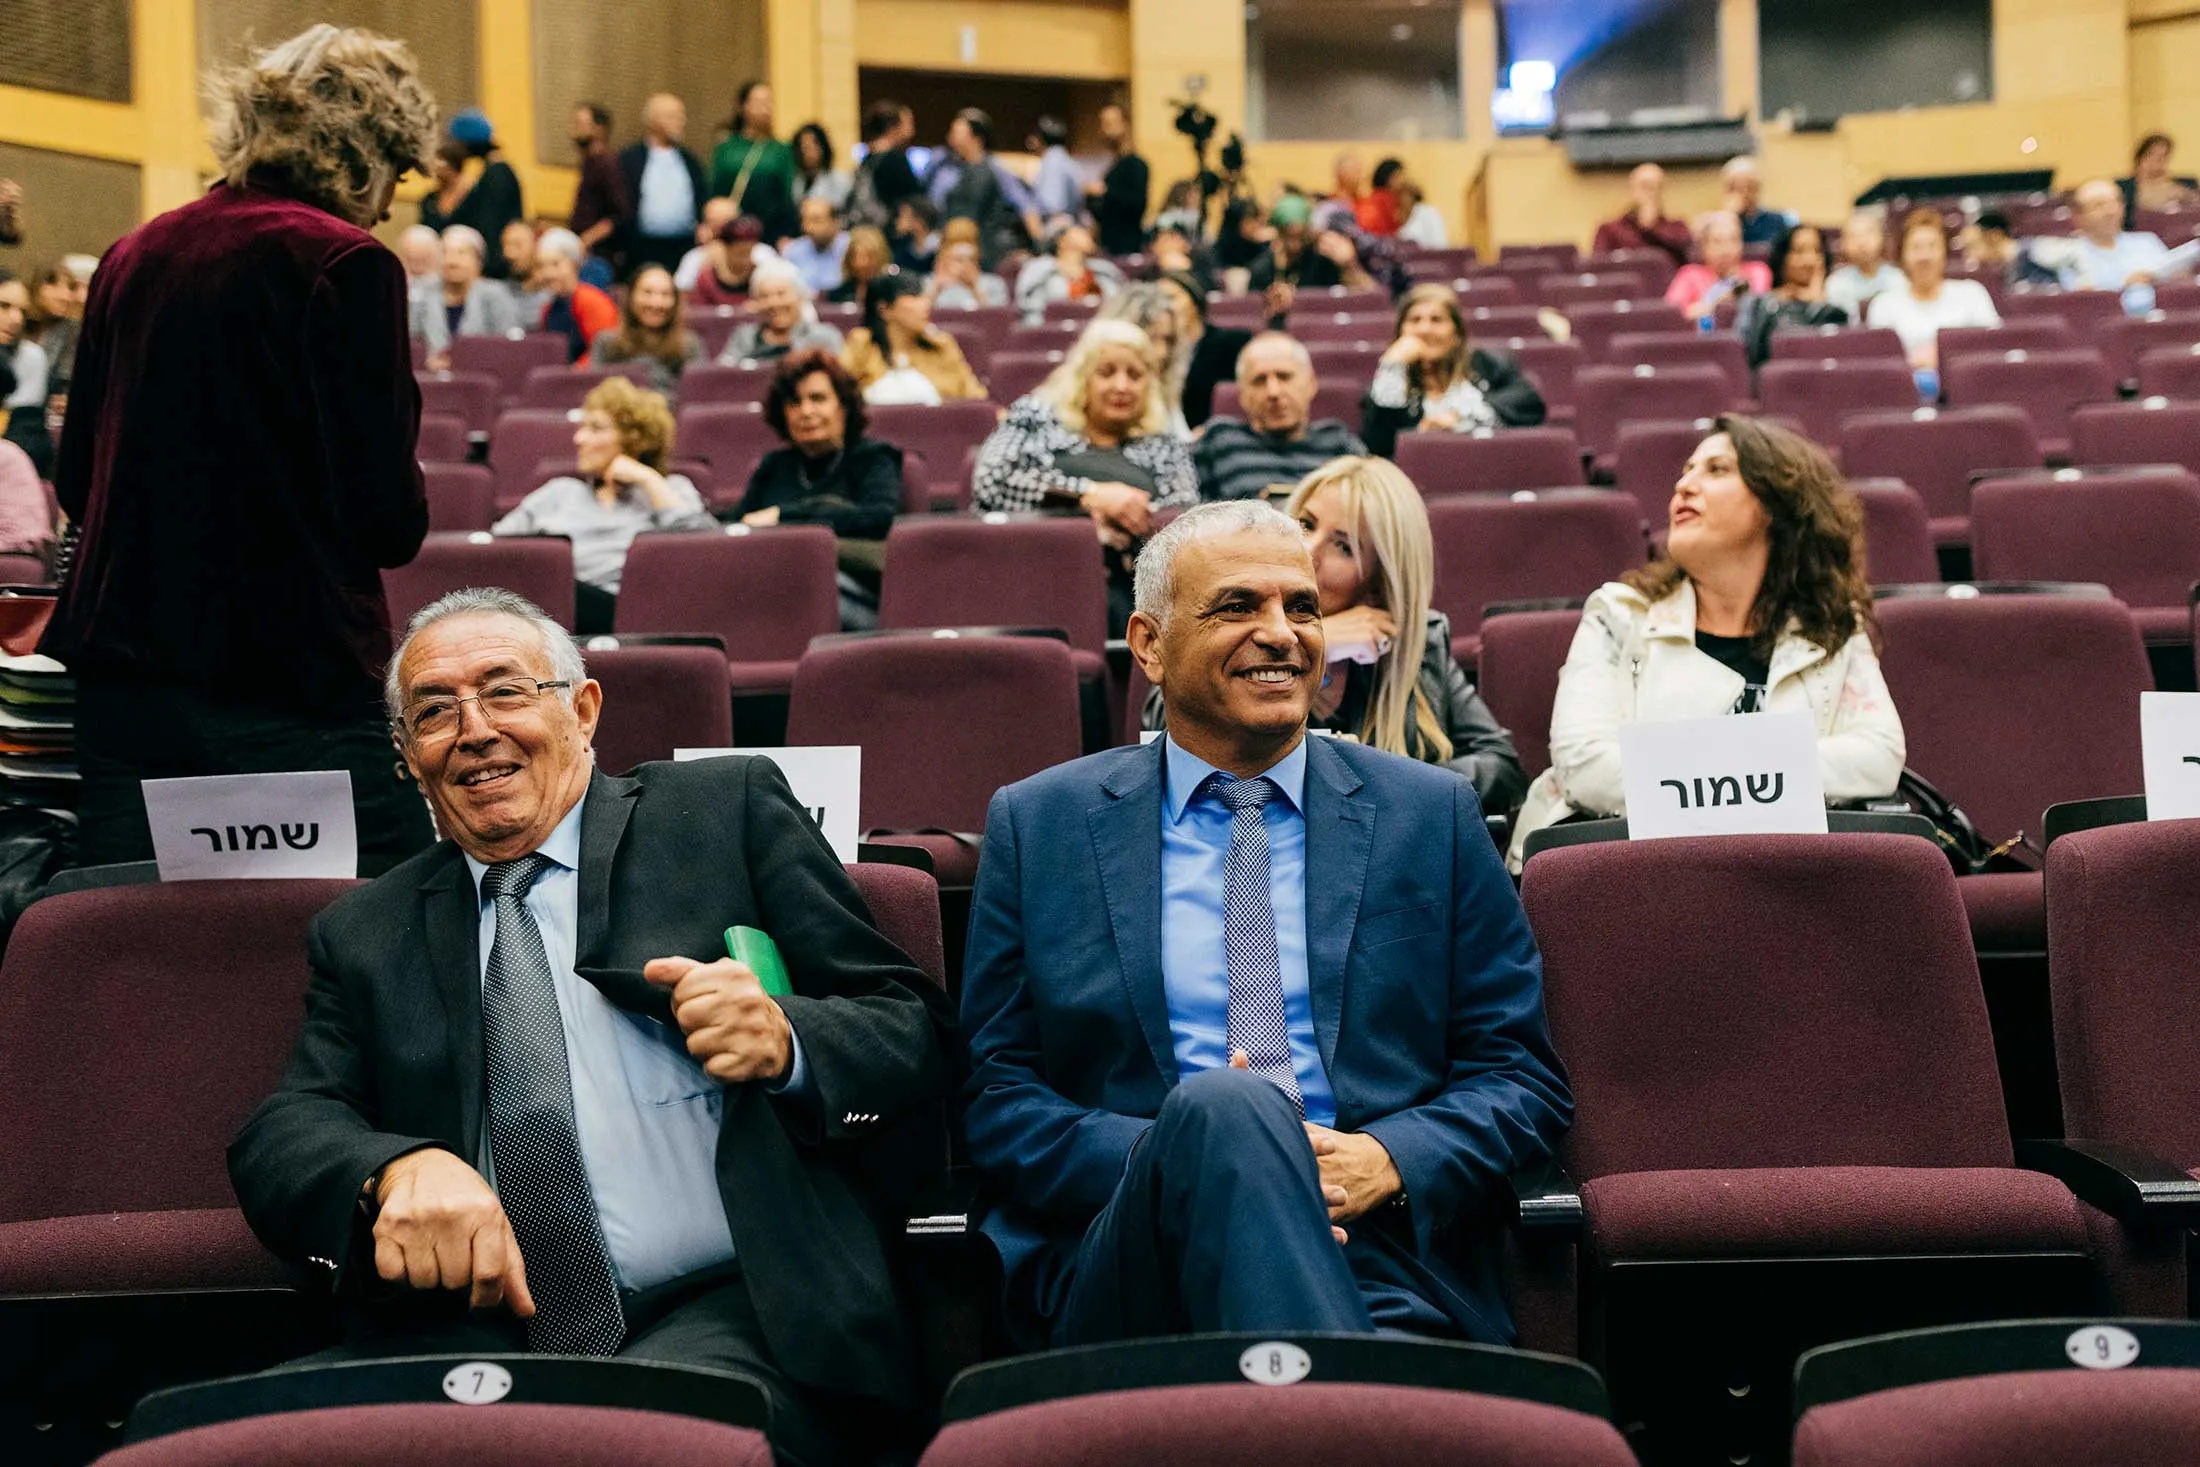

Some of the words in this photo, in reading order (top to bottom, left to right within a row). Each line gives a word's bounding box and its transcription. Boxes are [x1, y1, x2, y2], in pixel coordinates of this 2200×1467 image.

[1660, 772, 1784, 809] שמור
[190, 822, 320, 853] שמור
[2095, 1334, 2110, 1361] 9
[1269, 1350, 1282, 1377] 8
[472, 1370, 485, 1396] 7
